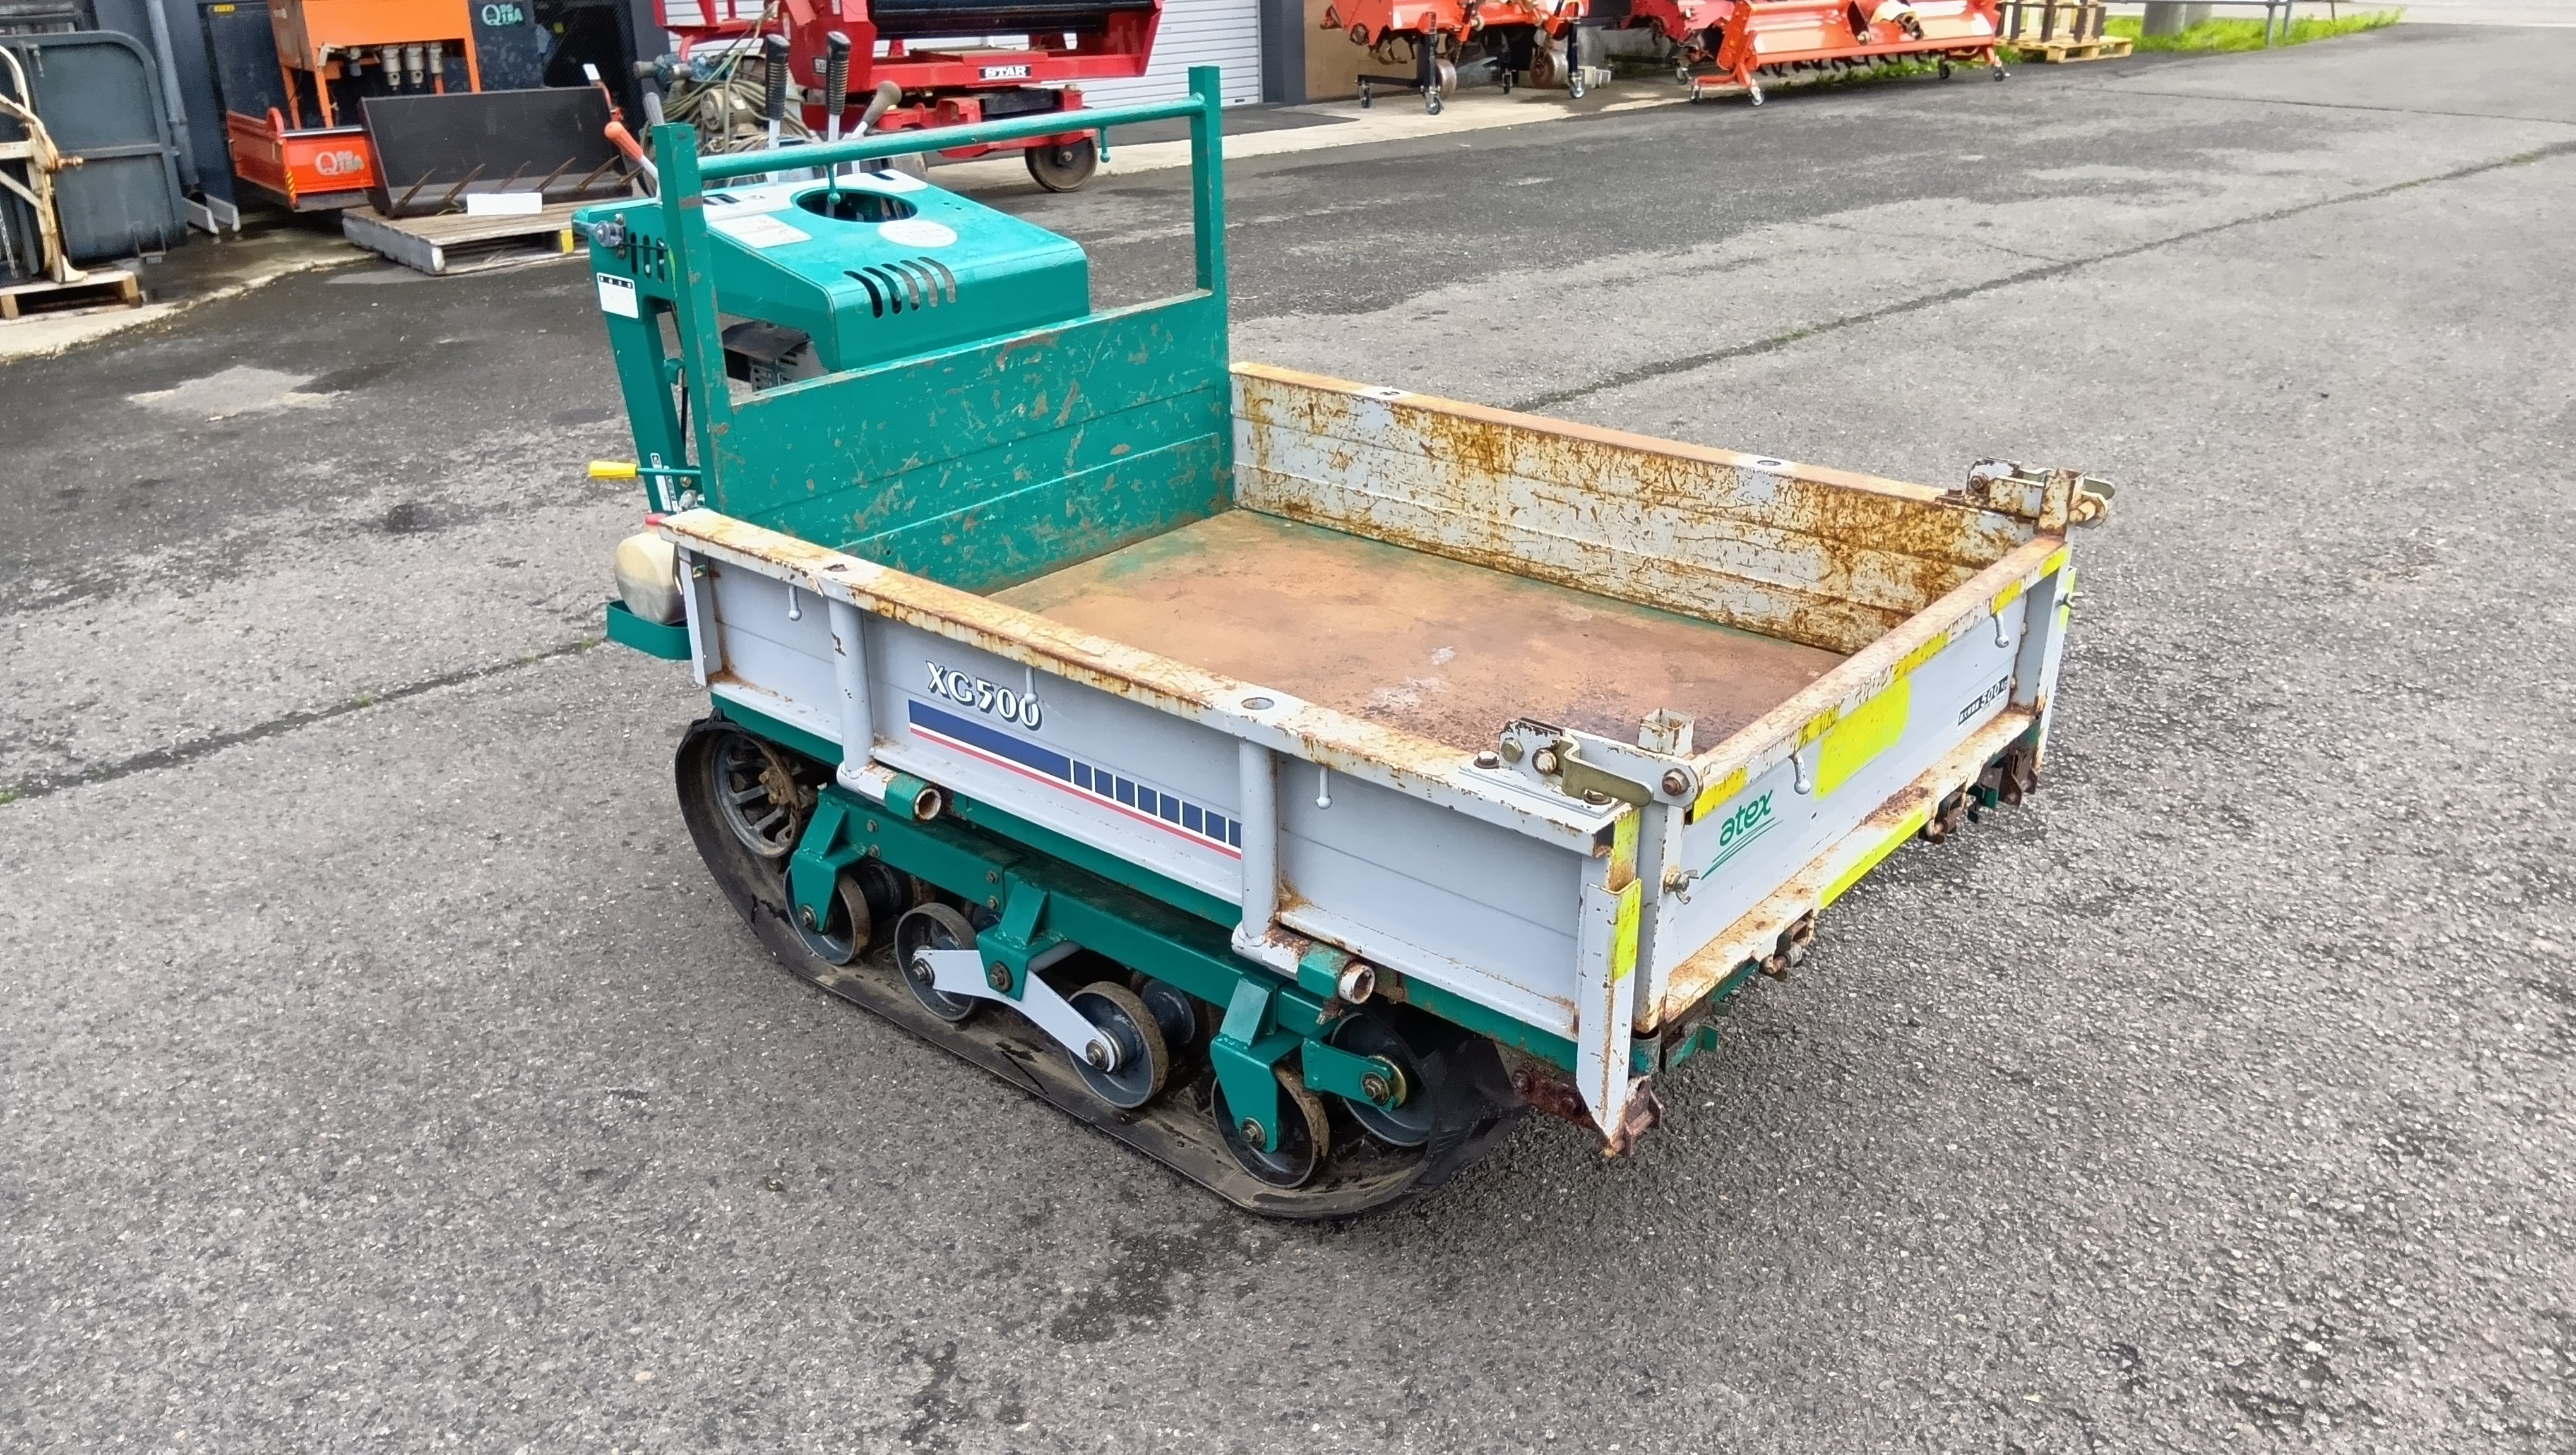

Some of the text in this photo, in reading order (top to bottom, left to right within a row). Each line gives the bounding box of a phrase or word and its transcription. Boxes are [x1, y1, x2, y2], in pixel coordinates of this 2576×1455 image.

[985, 66, 1026, 77] STAR
[926, 660, 1042, 731] XG500
[1720, 789, 1773, 846] atex
